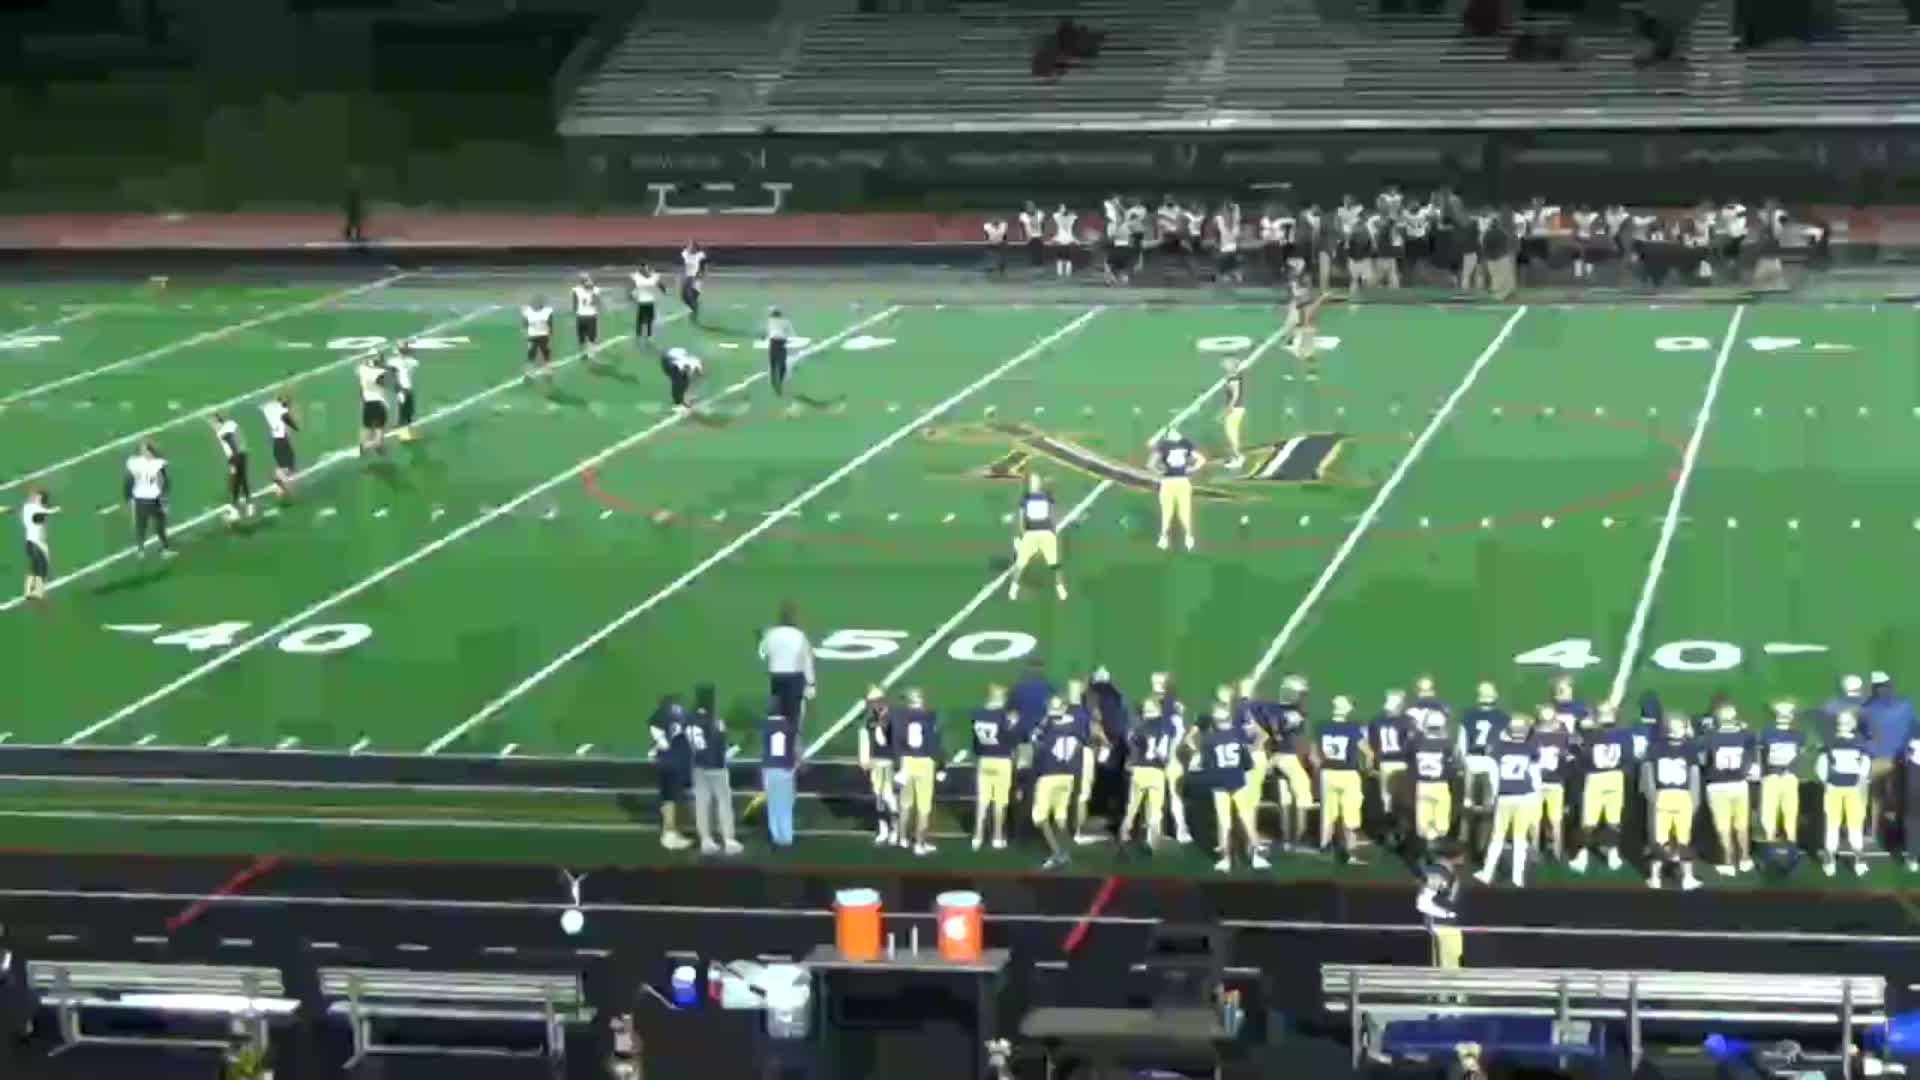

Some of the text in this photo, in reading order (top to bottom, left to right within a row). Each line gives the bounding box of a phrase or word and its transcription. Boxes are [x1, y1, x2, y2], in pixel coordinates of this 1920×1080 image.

[152, 621, 373, 653] 40
[814, 629, 1037, 662] 50
[1513, 638, 1742, 671] 40
[1475, 719, 1493, 746] 7
[1214, 742, 1242, 768] 15
